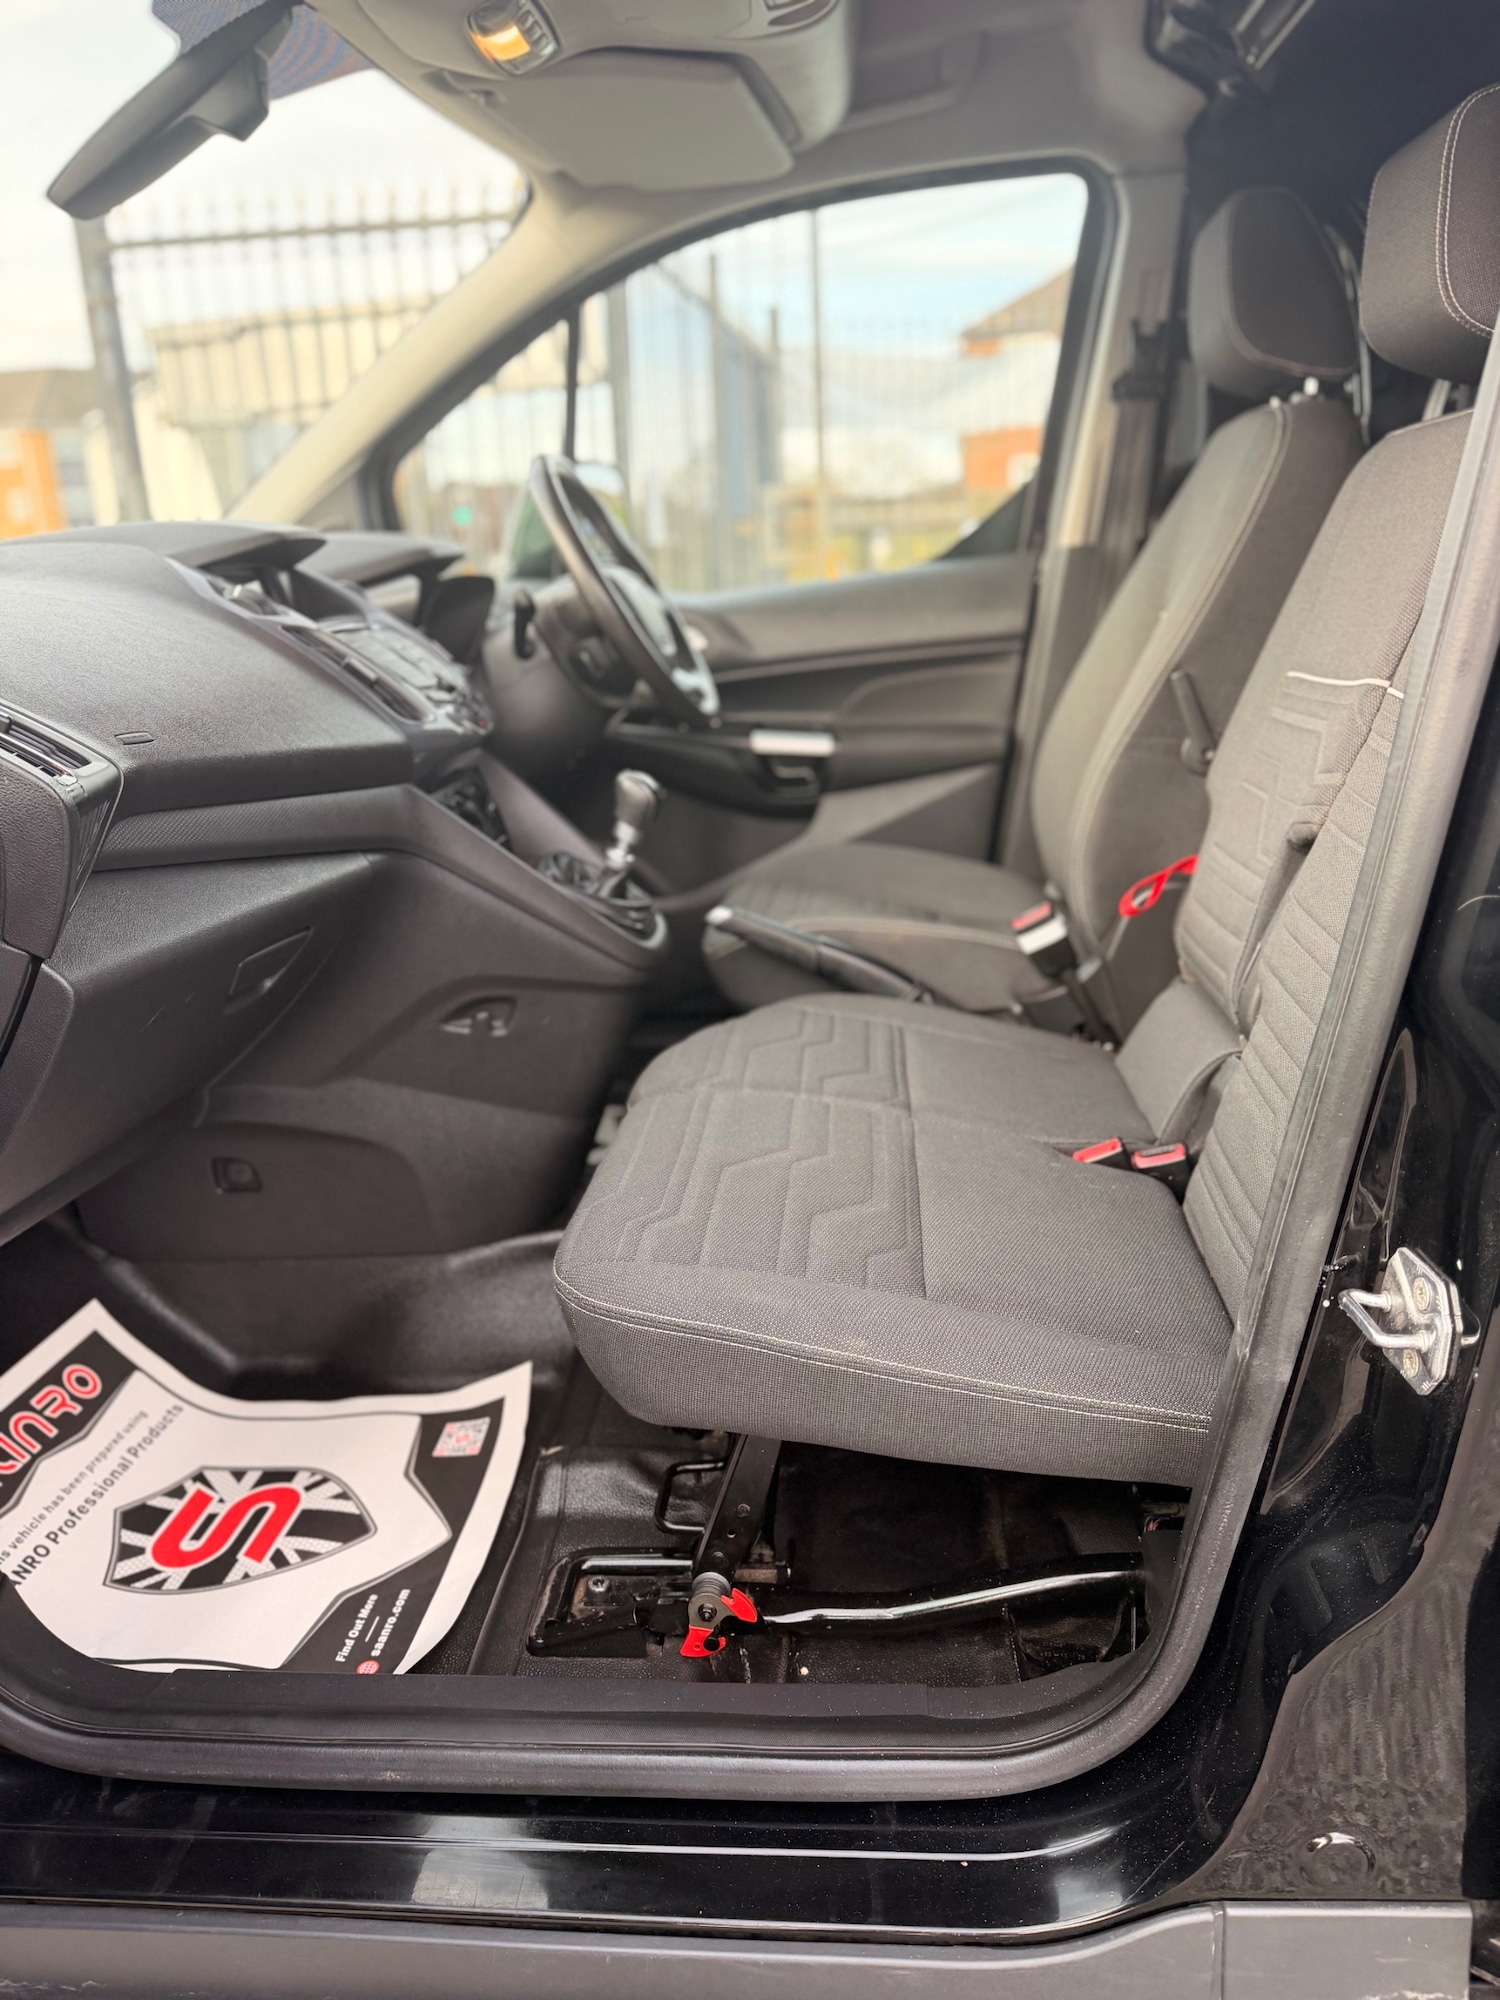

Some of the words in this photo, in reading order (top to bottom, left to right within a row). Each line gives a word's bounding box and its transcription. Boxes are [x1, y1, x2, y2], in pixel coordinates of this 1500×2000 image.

[8, 1512, 47, 1550] vehicle
[42, 1494, 65, 1514] has
[60, 1471, 88, 1496] been
[85, 1432, 125, 1474] prepared
[122, 1410, 149, 1434] using
[45, 1456, 134, 1545] Professional
[126, 1404, 185, 1459] Products
[335, 1638, 356, 1662] Find
[348, 1619, 366, 1638] Out
[357, 1594, 378, 1619] More
[370, 1589, 411, 1657] saanro.com
